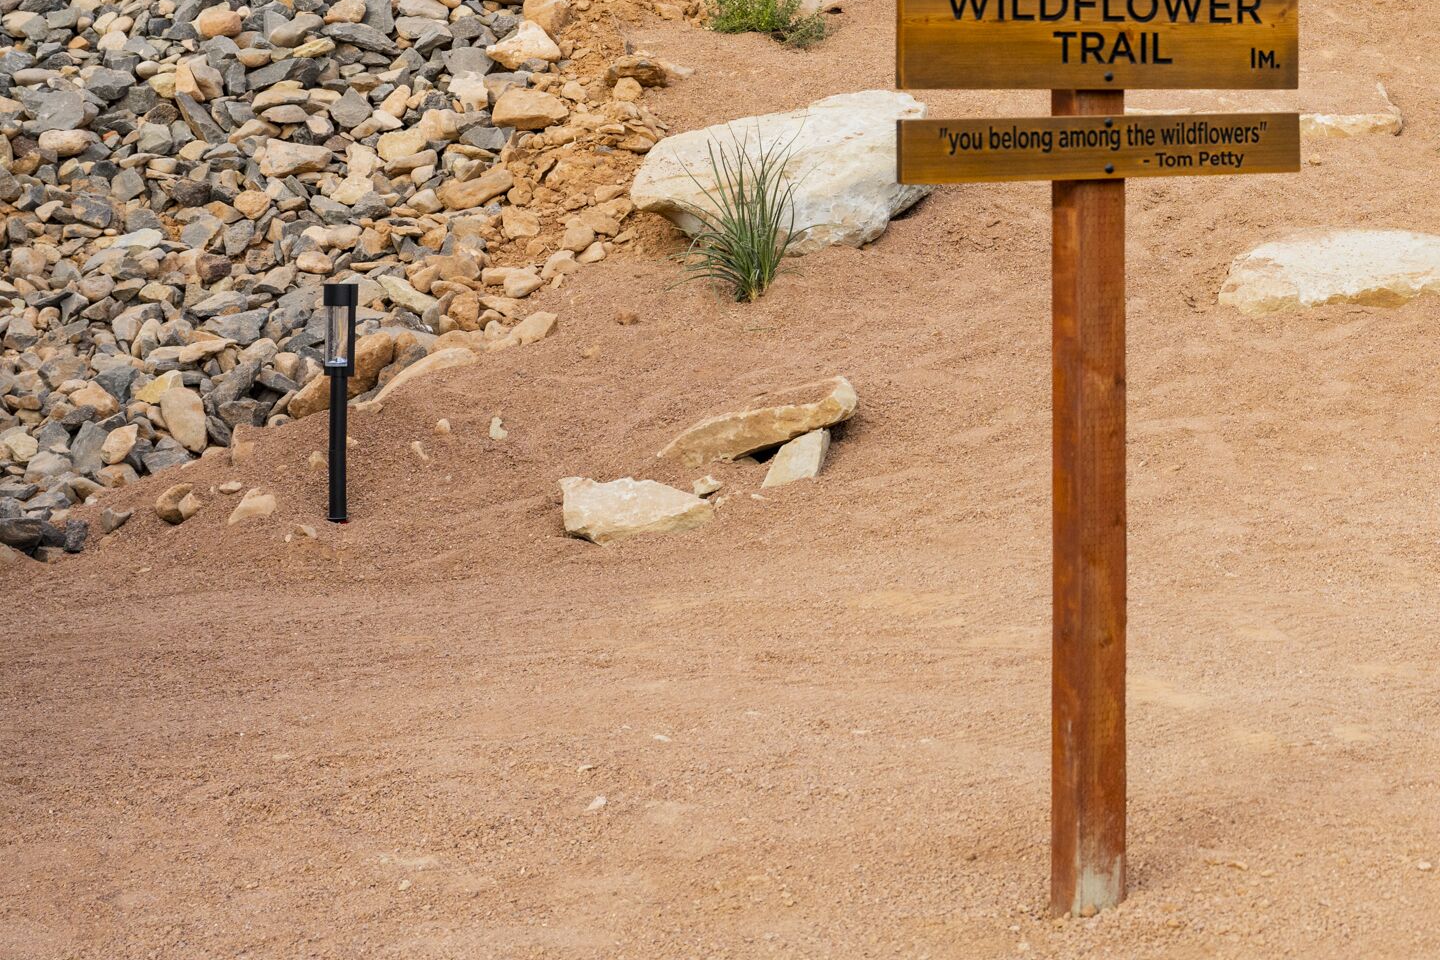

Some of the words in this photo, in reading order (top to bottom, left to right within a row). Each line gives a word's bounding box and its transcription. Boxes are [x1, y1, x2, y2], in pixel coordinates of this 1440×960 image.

[1053, 31, 1173, 65] TRAIL
[989, 126, 1053, 153] belong
[1058, 128, 1121, 151] among
[1127, 124, 1156, 146] the
[1160, 121, 1268, 145] wildflowers"
[1155, 152, 1193, 167] Tom
[1199, 151, 1244, 168] Petty
